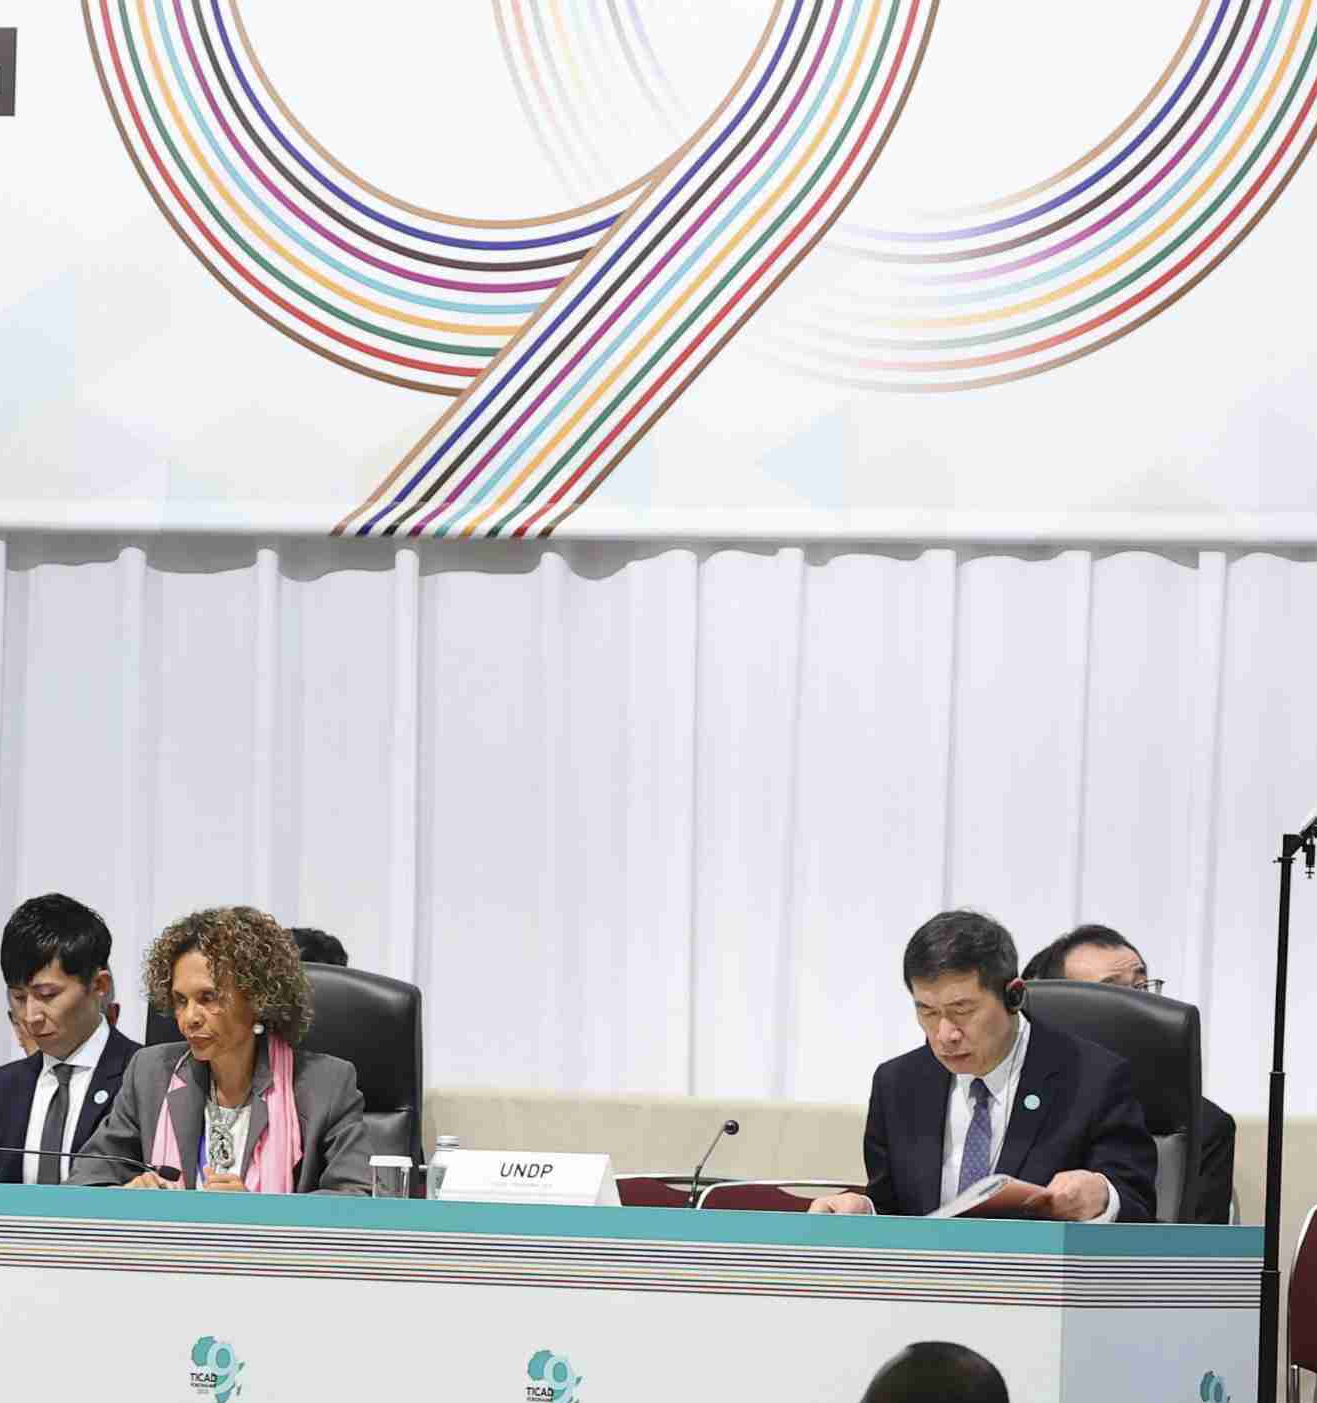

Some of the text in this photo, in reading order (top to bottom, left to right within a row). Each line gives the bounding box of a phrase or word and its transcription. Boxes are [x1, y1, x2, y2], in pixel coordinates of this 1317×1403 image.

[499, 1162, 554, 1179] UNDP
[190, 1373, 219, 1382] TICAD
[526, 1387, 555, 1397] TICAD
